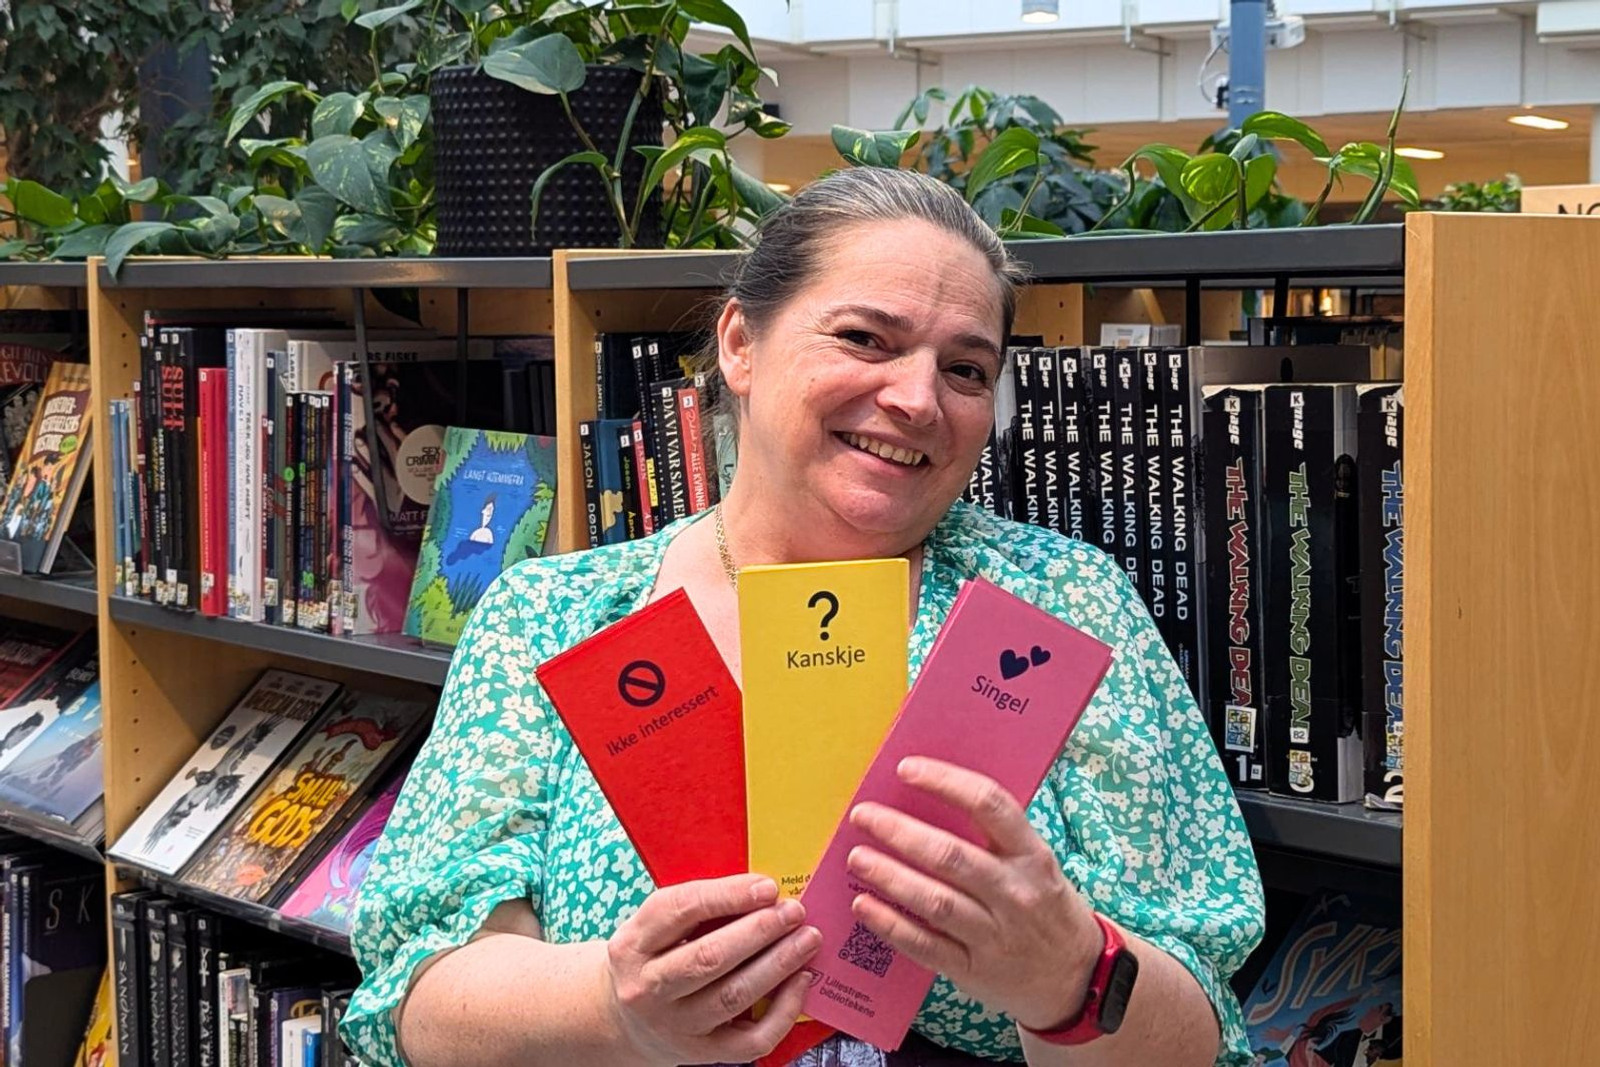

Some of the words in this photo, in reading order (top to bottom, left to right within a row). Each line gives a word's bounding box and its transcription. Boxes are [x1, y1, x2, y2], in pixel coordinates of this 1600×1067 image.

[173, 365, 185, 431] SULT
[1020, 399, 1034, 441] THE
[1042, 401, 1055, 443] THE
[1065, 401, 1079, 444] THE
[1098, 401, 1111, 443] THE
[1120, 403, 1134, 445] THE
[1145, 404, 1159, 447] THE
[1170, 405, 1183, 447] THE
[582, 443, 594, 488] JASON
[623, 456, 632, 490] Jason
[667, 438, 681, 470] VAR
[981, 446, 995, 516] WALKI
[1023, 449, 1040, 524] WALKIN
[1067, 451, 1083, 541] WALKING
[1100, 451, 1116, 544] WALKING
[1122, 454, 1136, 548] WALKING
[1147, 455, 1163, 550] WALKING
[1172, 456, 1187, 551] WALKING
[1225, 456, 1249, 521] THE
[1288, 462, 1311, 527] THE
[1381, 460, 1403, 527] THE
[1125, 557, 1138, 584] DE
[1151, 559, 1165, 618] DEAD
[1175, 561, 1188, 621] DEAD
[1227, 521, 1251, 644] WALKING
[1289, 527, 1312, 655] WALKING
[1383, 526, 1404, 662] WALKING
[786, 645, 866, 670] Kanskje
[1228, 645, 1252, 707] DEA
[606, 725, 638, 758] Ikke
[637, 684, 721, 744] interessert
[970, 673, 1031, 716] Singel
[1289, 656, 1312, 728] DEA
[1384, 659, 1404, 728] DEA
[287, 772, 342, 807] SMALL
[1236, 755, 1247, 782] 1
[248, 800, 324, 849] GODS
[781, 874, 804, 886] Meld
[118, 960, 130, 1055] SANDMAN
[150, 966, 160, 1061] SANDMAN
[818, 987, 876, 1018] bibliotekene
[824, 975, 873, 1003] Lillestrøm-
